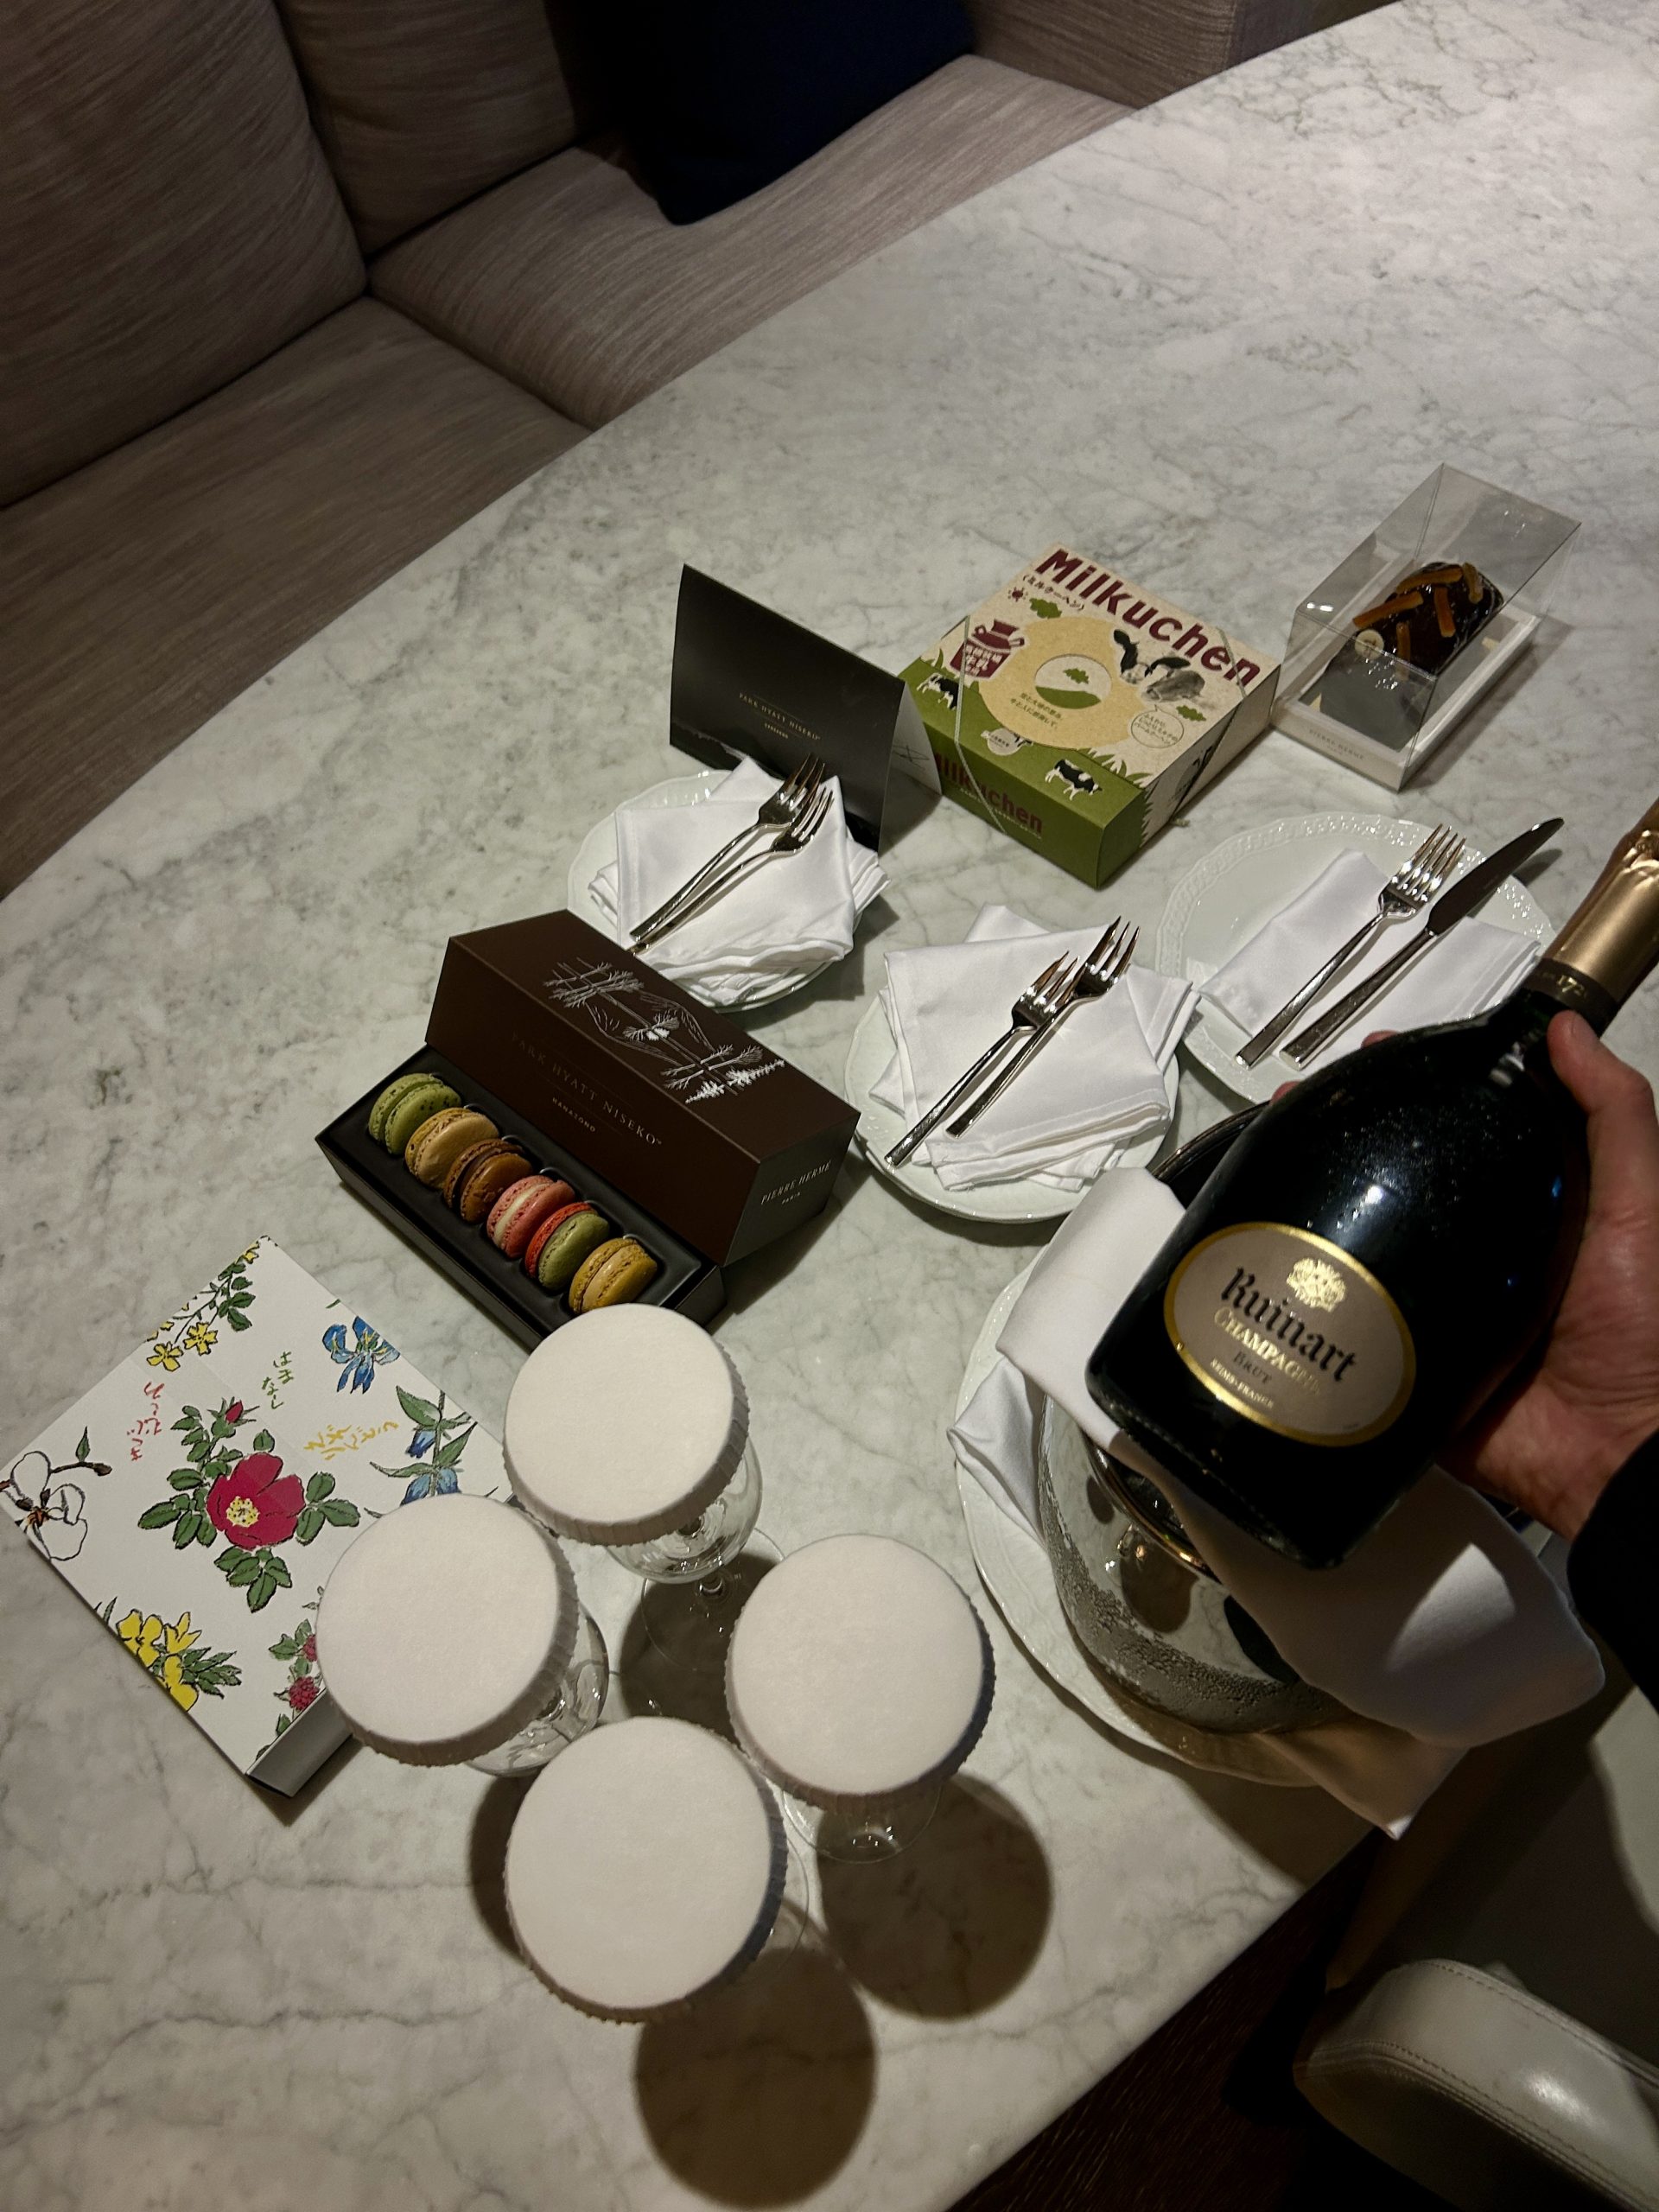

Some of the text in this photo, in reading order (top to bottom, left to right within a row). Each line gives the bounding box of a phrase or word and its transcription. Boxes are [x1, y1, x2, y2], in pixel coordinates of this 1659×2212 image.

[1034, 548, 1262, 686] Milkuchen
[552, 1063, 597, 1101] HYATT
[552, 1096, 596, 1133] HANAZONO
[761, 1179, 797, 1206] PIERRE
[1220, 1267, 1357, 1382] Ruinart
[262, 1351, 295, 1410] はまなし
